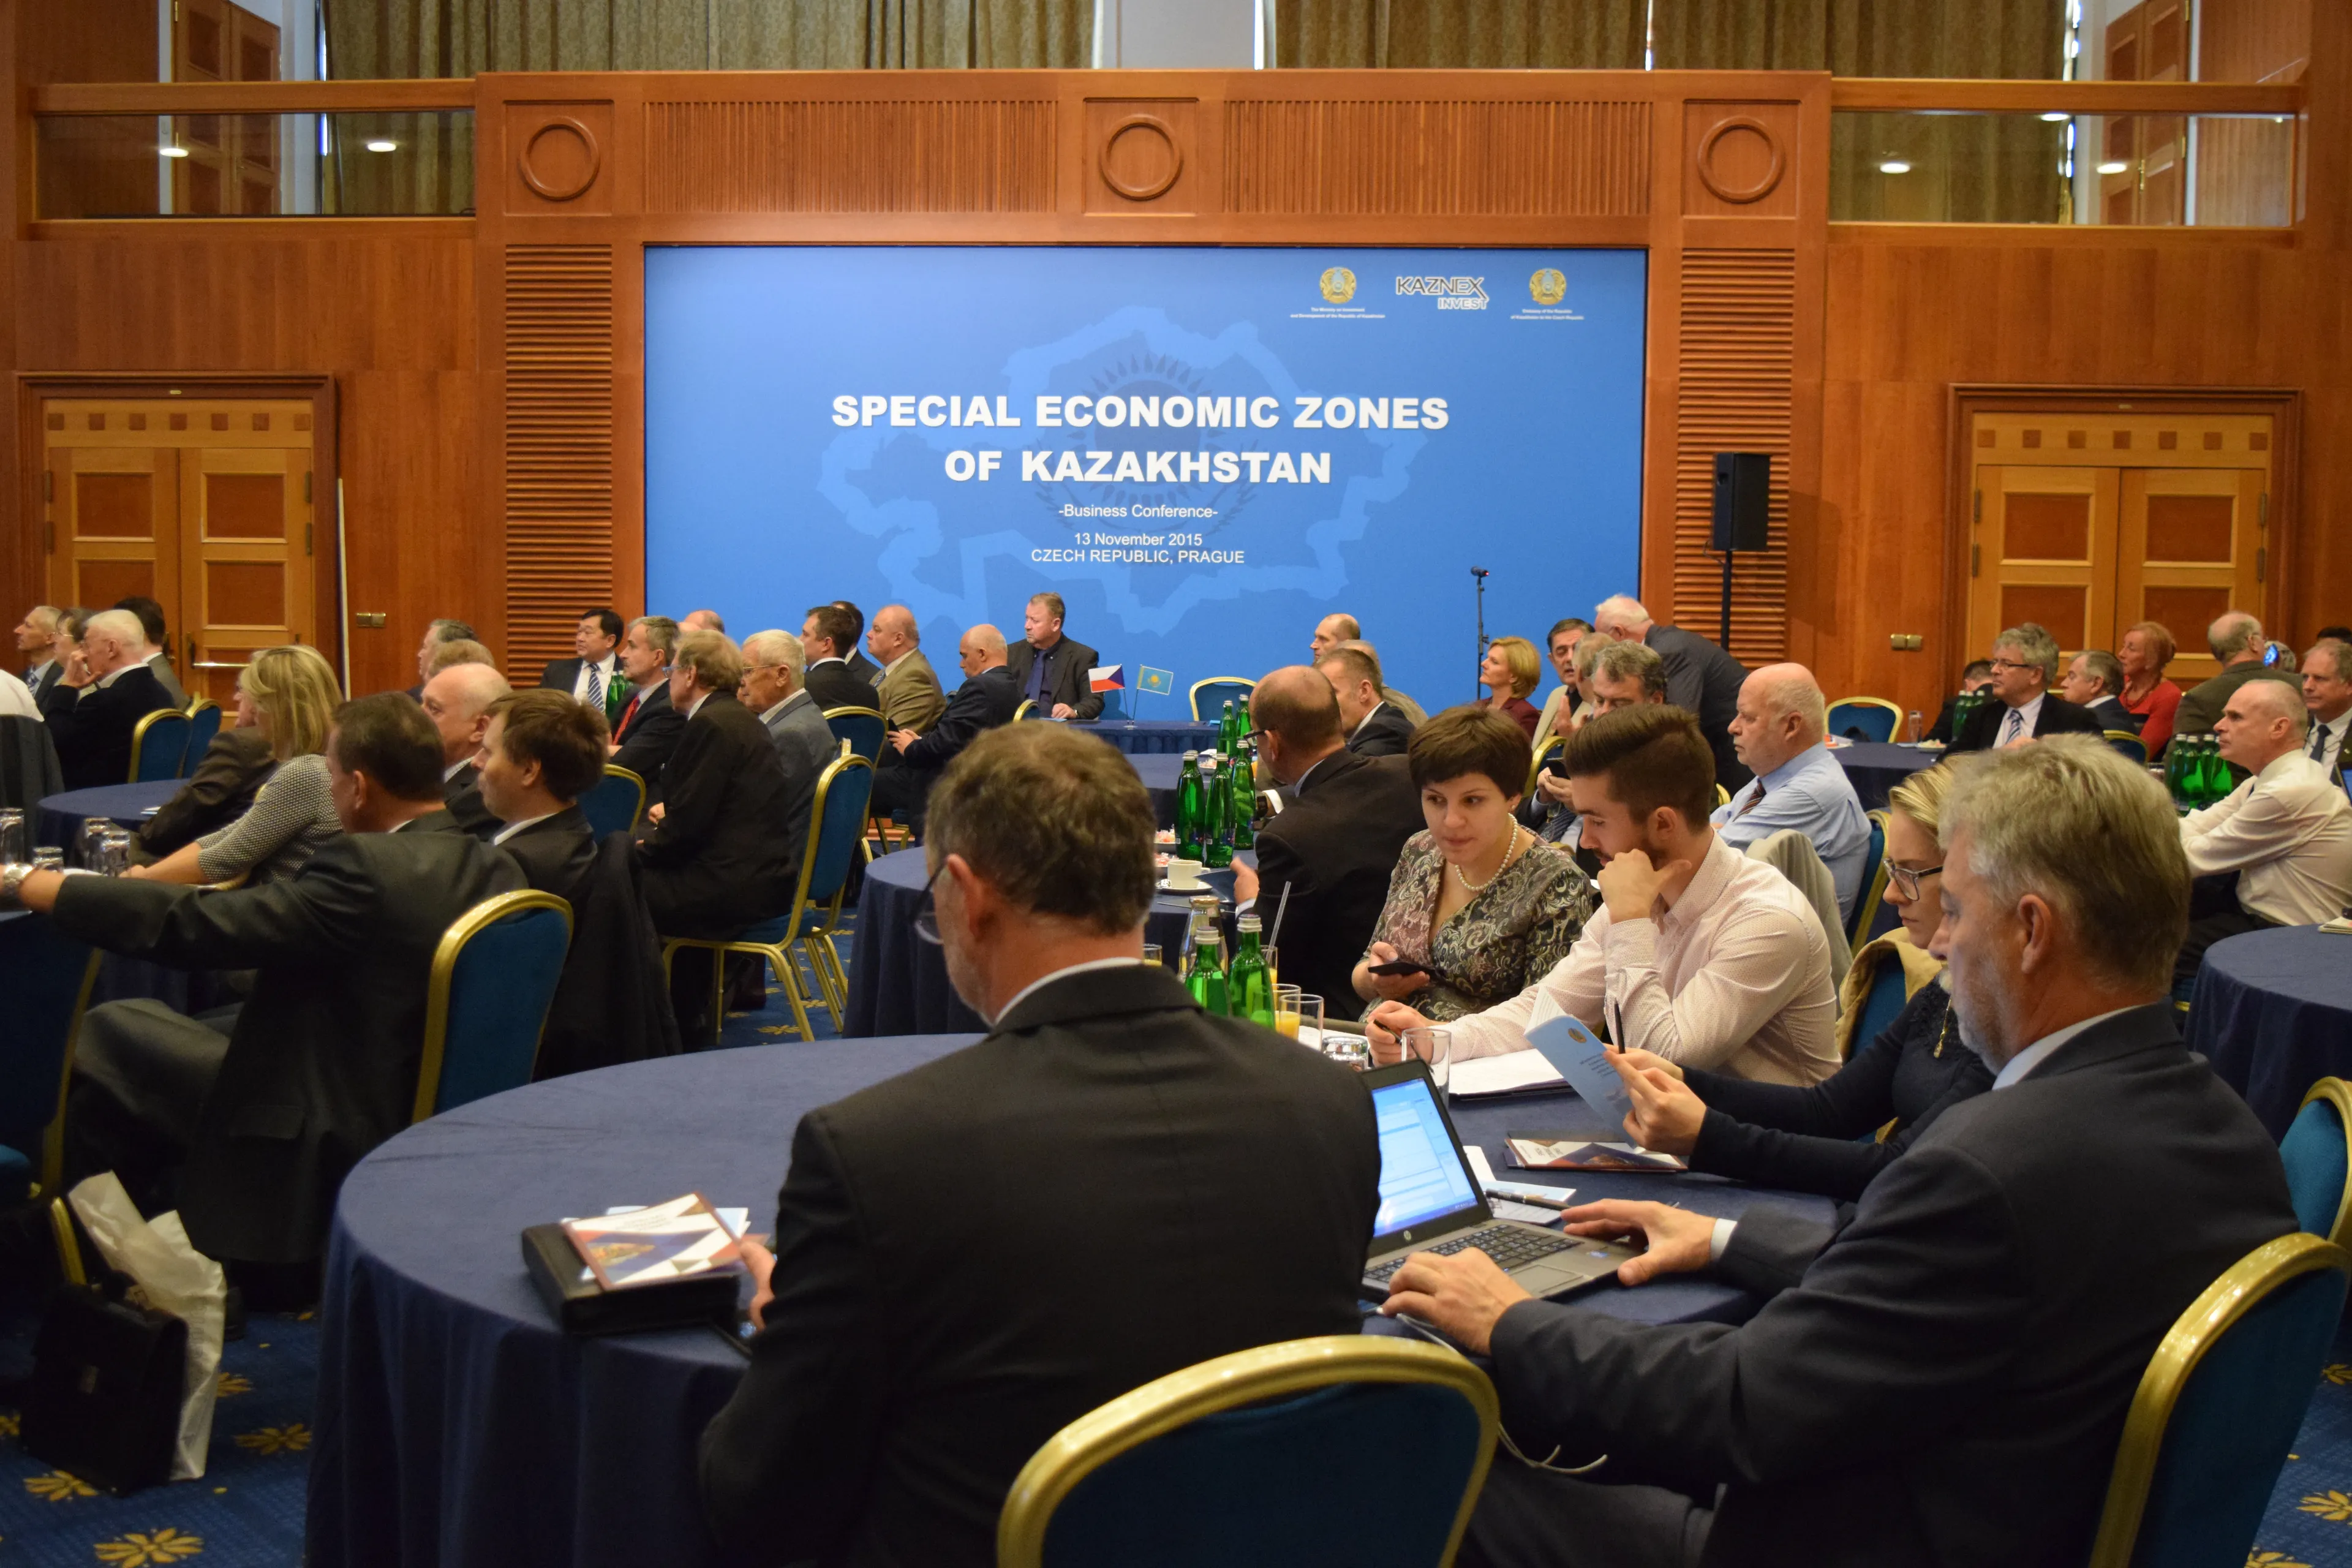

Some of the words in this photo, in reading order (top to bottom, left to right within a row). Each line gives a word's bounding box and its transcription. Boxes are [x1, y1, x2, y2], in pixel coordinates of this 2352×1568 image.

[1396, 276, 1488, 300] KAZNEX
[1438, 297, 1487, 309] INVEST
[832, 395, 1021, 428] SPECIAL
[1036, 395, 1280, 428] ECONOMIC
[1294, 396, 1449, 430] ZONES
[944, 450, 1002, 481] OF
[1022, 450, 1331, 483] KAZAKHSTAN
[1058, 504, 1128, 518] -Business
[1132, 505, 1218, 518] Conference-
[1075, 533, 1091, 545] 13
[1095, 532, 1165, 546] November
[1168, 533, 1202, 546] 2015
[1031, 549, 1085, 562] CZECH
[1090, 549, 1173, 564] REPUBLIC,
[1178, 550, 1245, 564] PRAGUE
